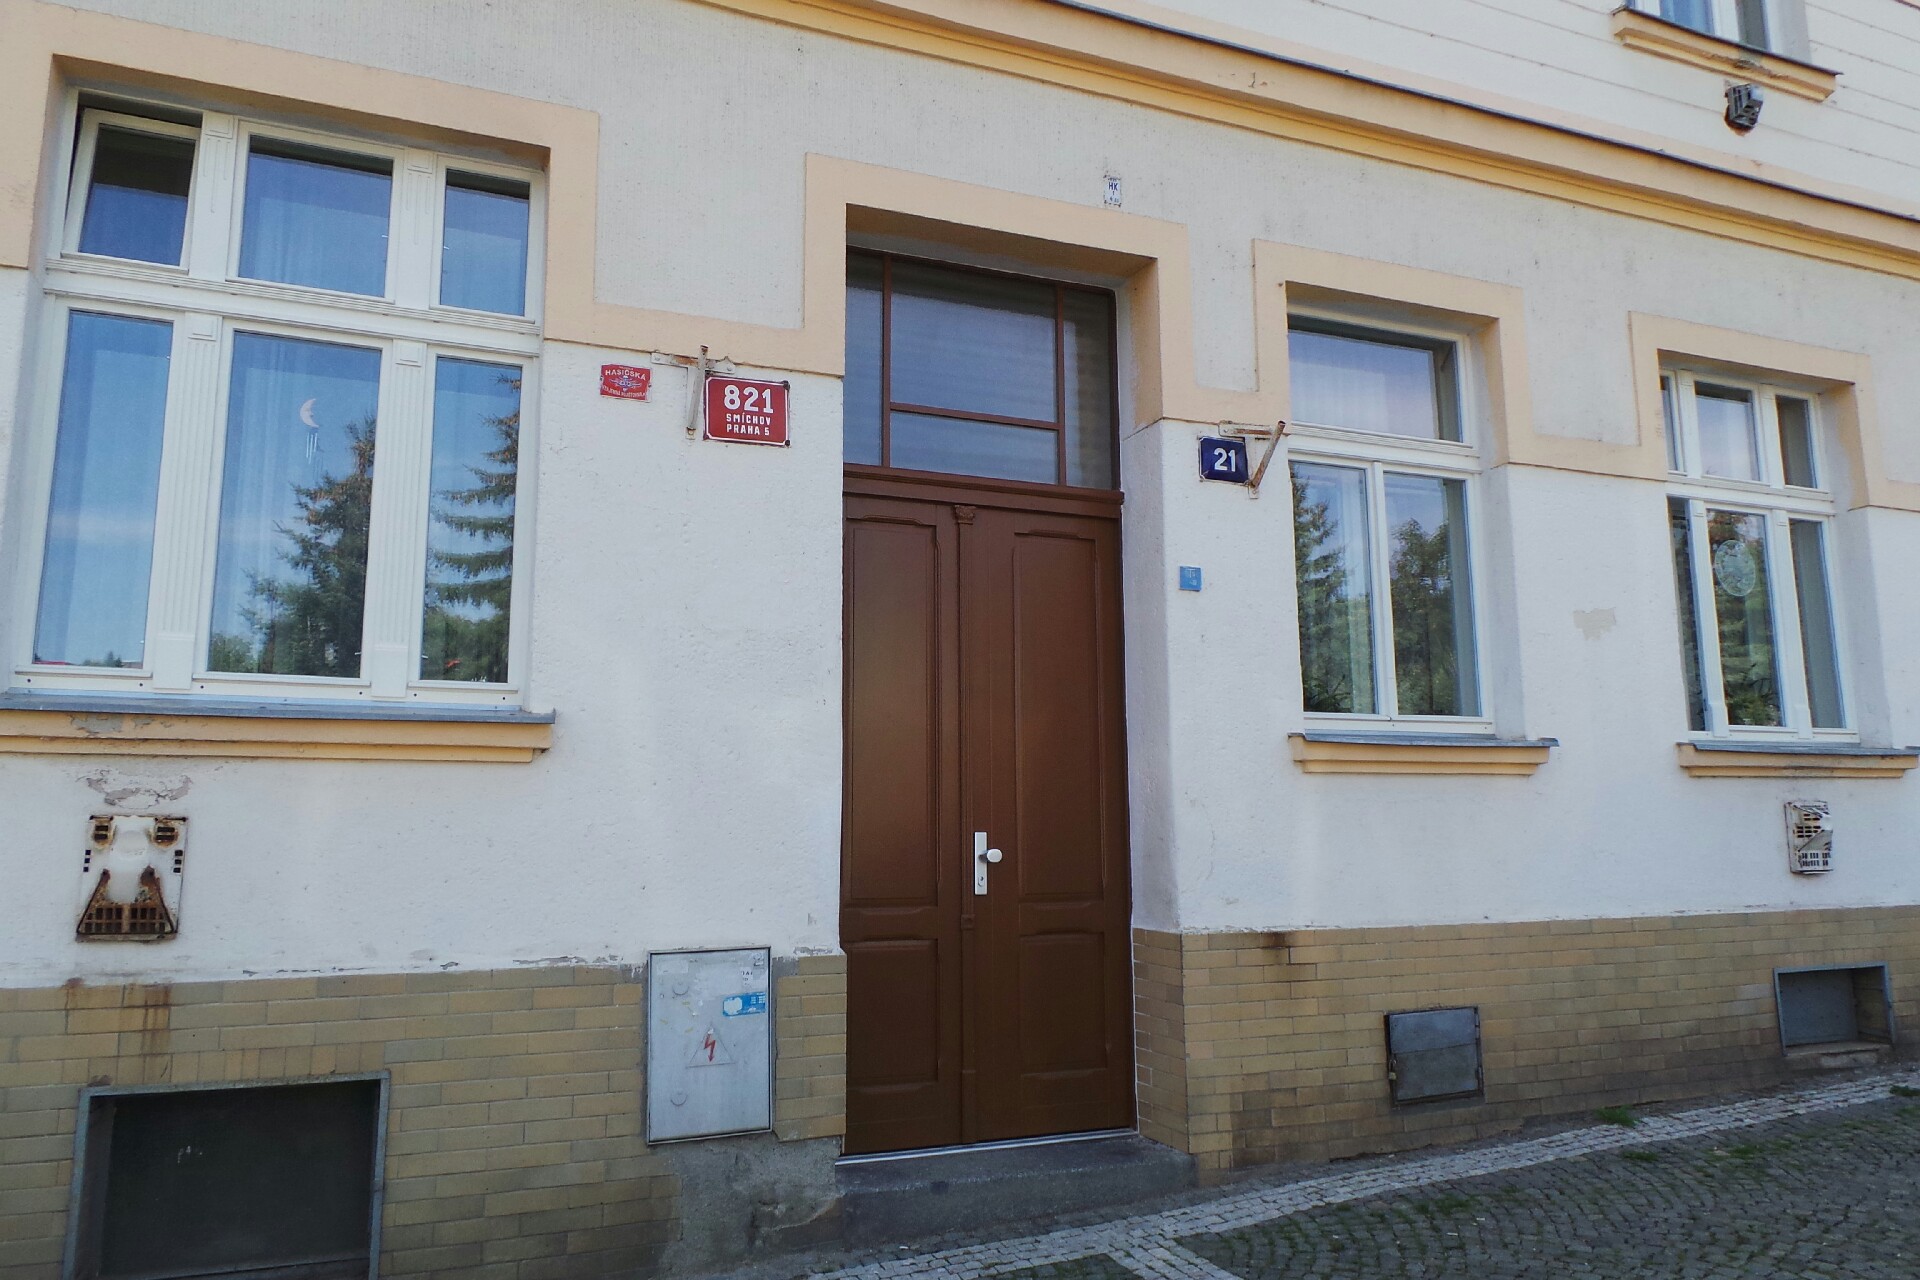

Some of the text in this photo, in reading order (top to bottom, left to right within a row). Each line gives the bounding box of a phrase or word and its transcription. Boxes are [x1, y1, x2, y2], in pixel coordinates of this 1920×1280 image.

[1108, 181, 1118, 191] HK
[723, 384, 774, 414] 821
[726, 412, 771, 426] SMÍCHOV
[726, 423, 770, 436] PRAHA 5
[1213, 447, 1236, 473] 21
